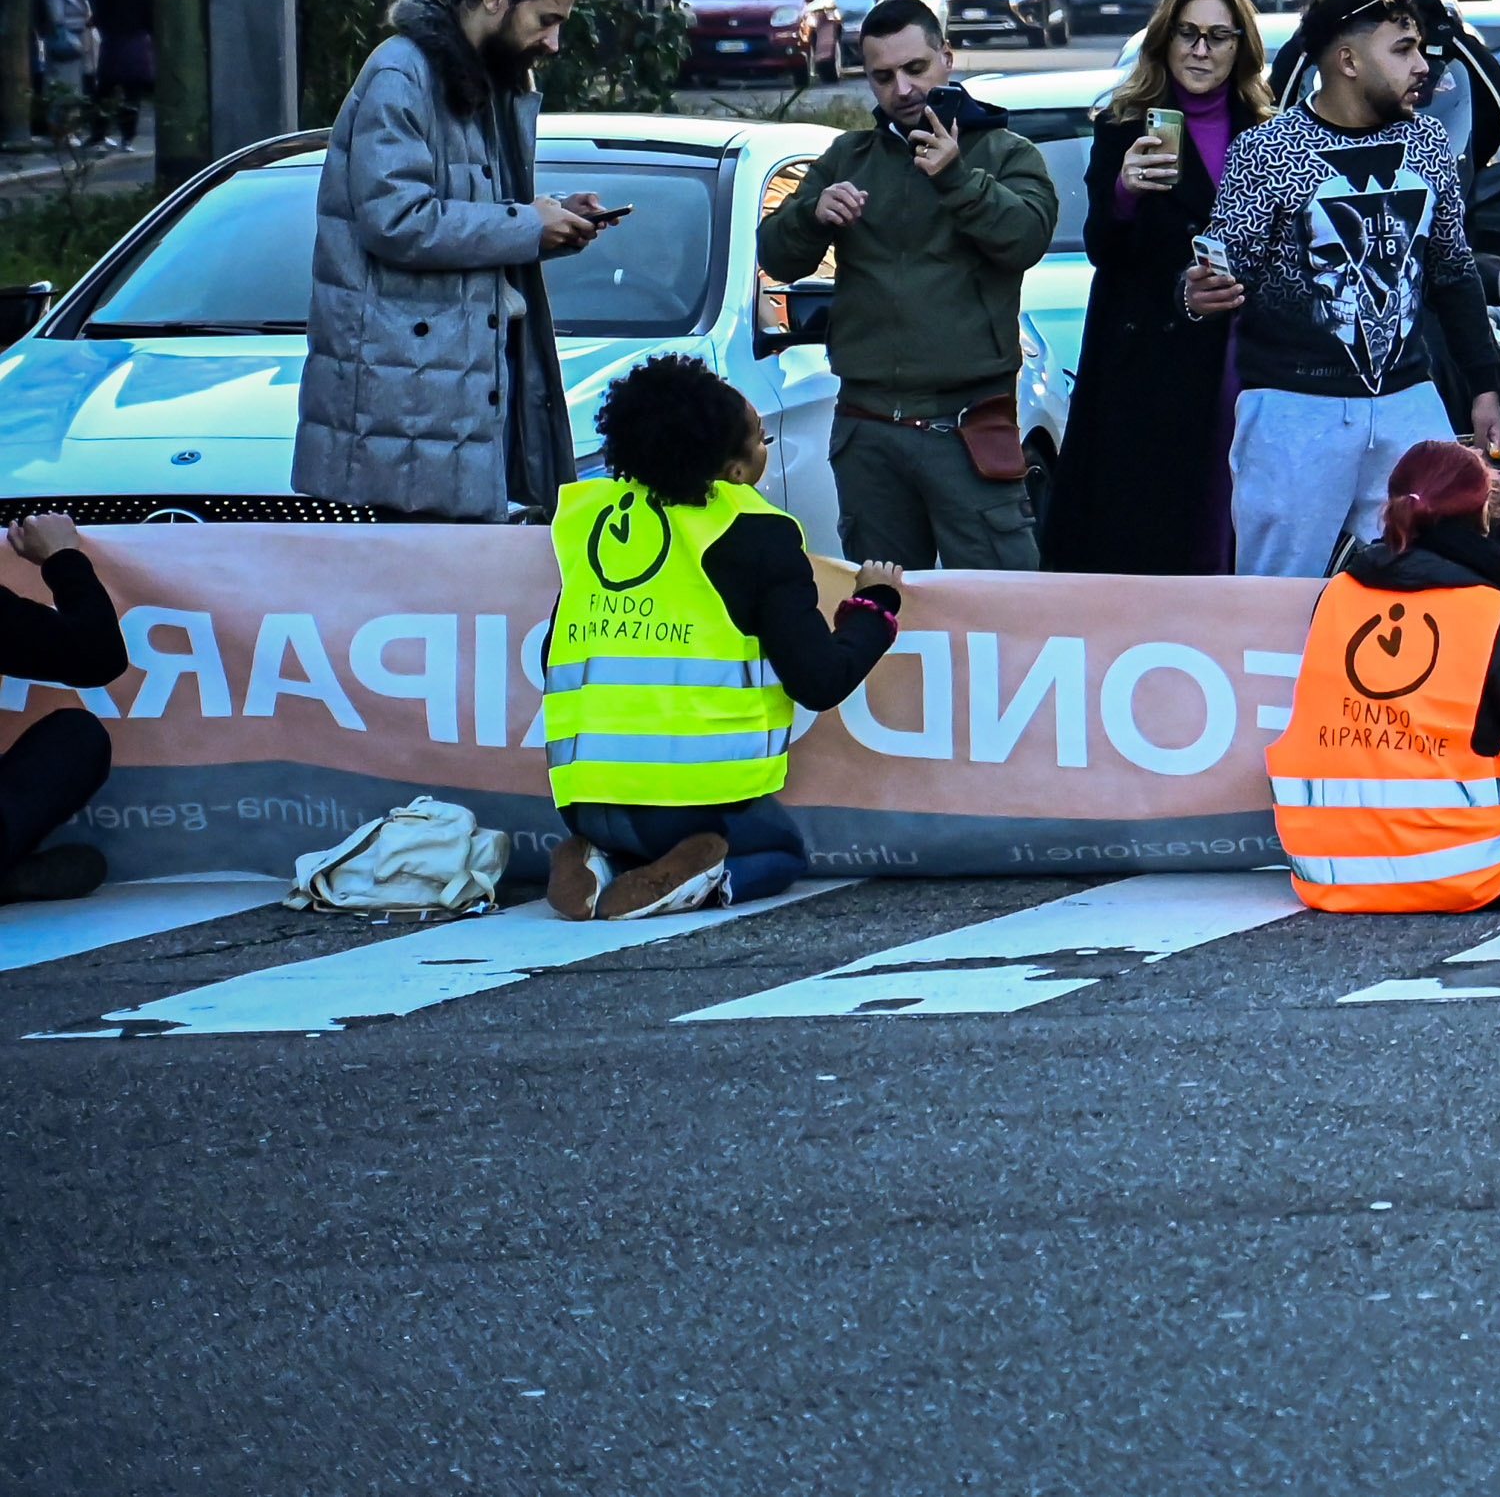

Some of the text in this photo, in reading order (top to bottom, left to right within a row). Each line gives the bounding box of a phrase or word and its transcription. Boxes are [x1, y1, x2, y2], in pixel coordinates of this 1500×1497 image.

[590, 593, 654, 617] FNDO
[1343, 697, 1410, 728] FONDO
[1319, 725, 1449, 757] RIPARAZIONE
